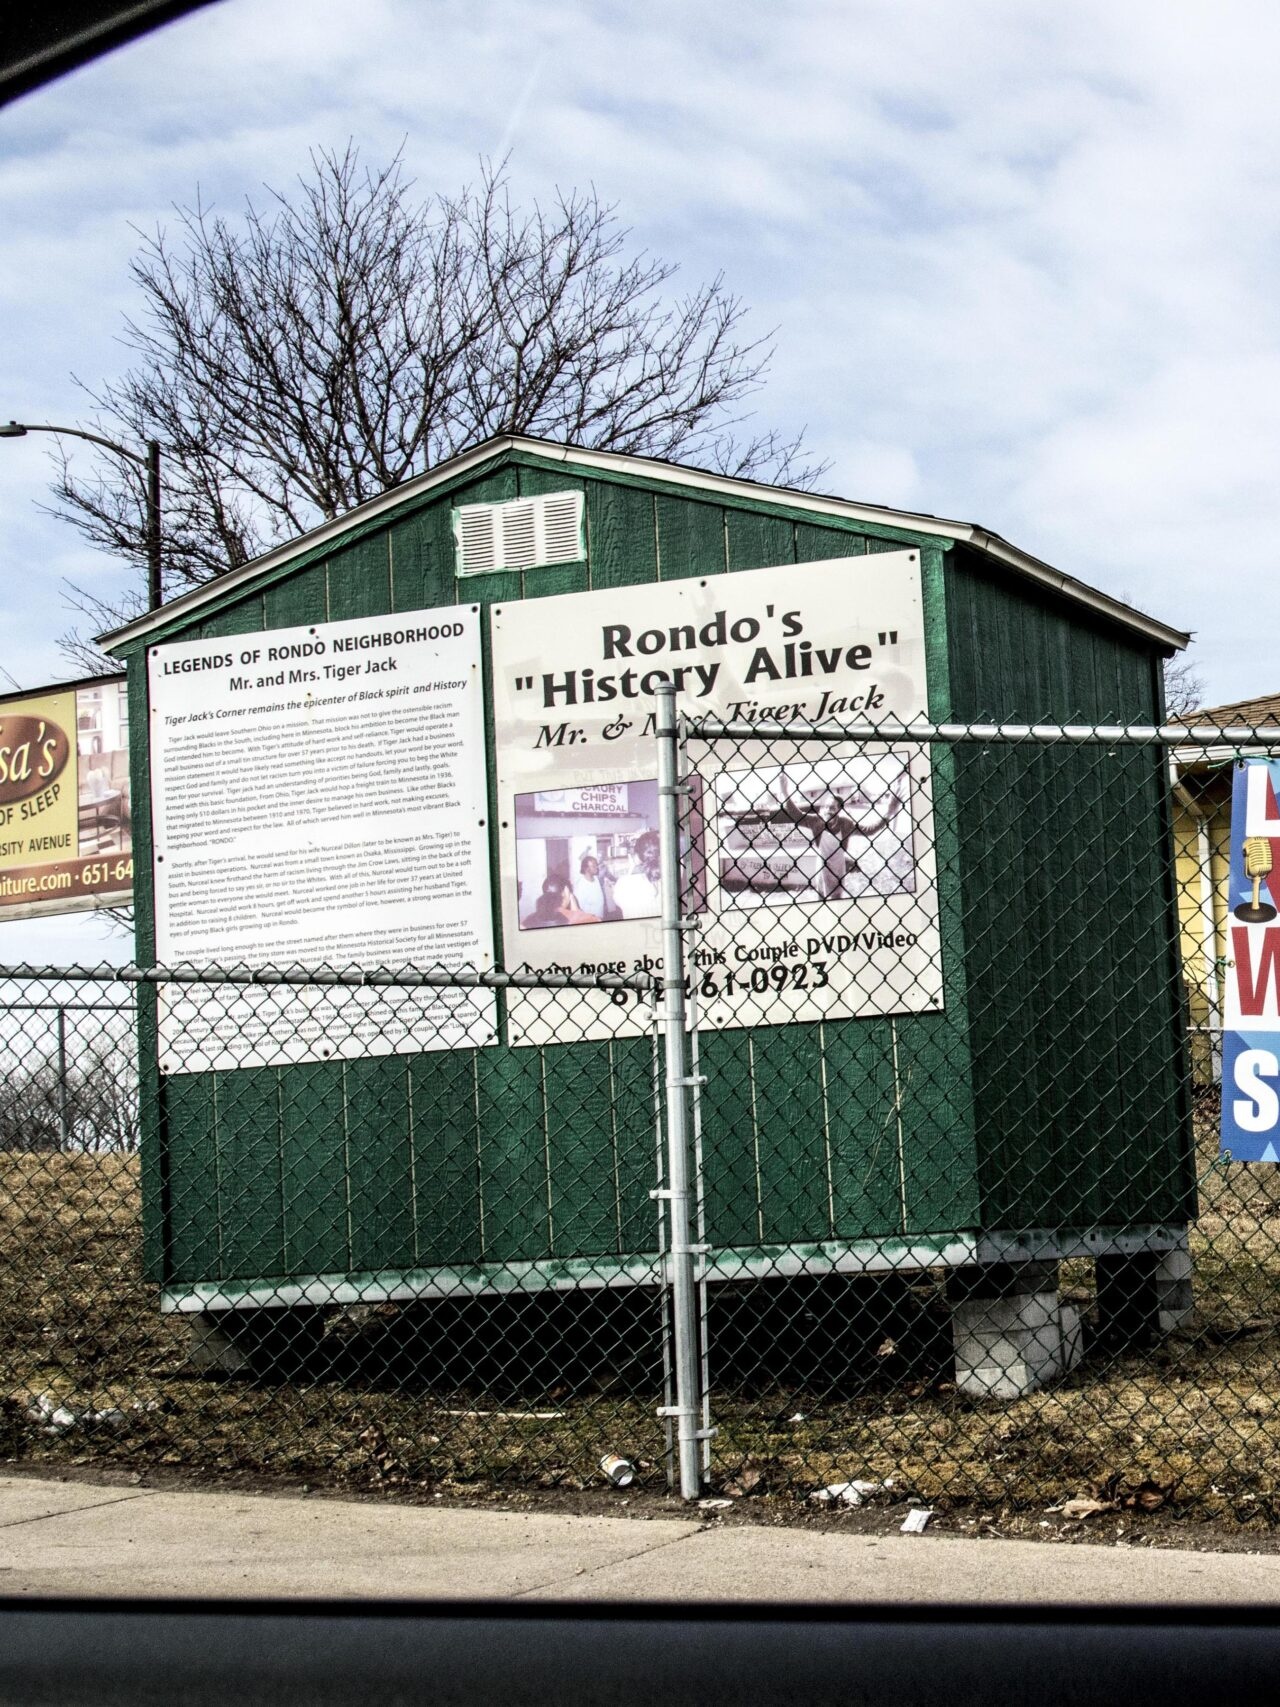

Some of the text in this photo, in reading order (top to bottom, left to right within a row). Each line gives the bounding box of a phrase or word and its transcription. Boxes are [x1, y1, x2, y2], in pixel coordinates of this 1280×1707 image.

[163, 621, 464, 675] LEGENDS OF RONDO NEIGHBORHOOD
[602, 604, 803, 660] Rondo's
[228, 655, 397, 691] Mr. and Mrs. Tiger Jack
[515, 630, 898, 708] "History Alive"
[164, 678, 468, 727] Tiger Jack's Corner remains the epicenter of Black spirit and History
[168, 735, 182, 744] Tiger
[183, 733, 195, 741] Jack
[195, 731, 214, 739] would
[213, 729, 229, 737] leave
[230, 726, 257, 735] Southern
[257, 724, 272, 732] Ohio
[311, 717, 324, 725] That
[324, 714, 347, 723] mission
[359, 711, 370, 719] not
[378, 709, 391, 718] give
[432, 701, 452, 710] racism
[532, 722, 588, 749] Mr.
[602, 713, 633, 740] &
[726, 701, 807, 724] Tiger
[810, 684, 885, 723] Jack
[0, 721, 57, 783] sa's
[163, 743, 198, 754] surrounding
[197, 741, 216, 749] Blacks
[252, 733, 281, 743] including
[280, 731, 294, 739] here
[333, 724, 350, 732] block
[359, 720, 386, 729] ambition
[393, 716, 418, 725] become
[418, 714, 429, 722] the
[429, 712, 446, 720] Black
[0, 783, 61, 826] OF SLEEP
[572, 801, 626, 812] CHARCOAL
[581, 792, 617, 803] CHIPS
[0, 833, 71, 856] SITY AVENUE
[255, 851, 274, 859] would
[392, 835, 414, 844] known
[0, 871, 71, 897] iture.com
[168, 931, 183, 939] eyes
[190, 928, 209, 936] young
[208, 925, 224, 933] Black
[224, 924, 238, 933] girls
[238, 921, 262, 931] growing
[185, 947, 205, 957] couple
[220, 944, 234, 953] long
[234, 942, 257, 951] enough
[285, 937, 302, 945] street
[303, 935, 324, 943] named
[323, 933, 337, 941] after
[338, 931, 354, 939] them
[354, 929, 373, 937] where
[373, 928, 387, 937] they
[408, 923, 435, 932] business
[580, 960, 626, 975] more
[634, 954, 687, 972] abo
[693, 948, 727, 966] this
[734, 940, 799, 963] Couple
[807, 931, 918, 956] DVD/Video
